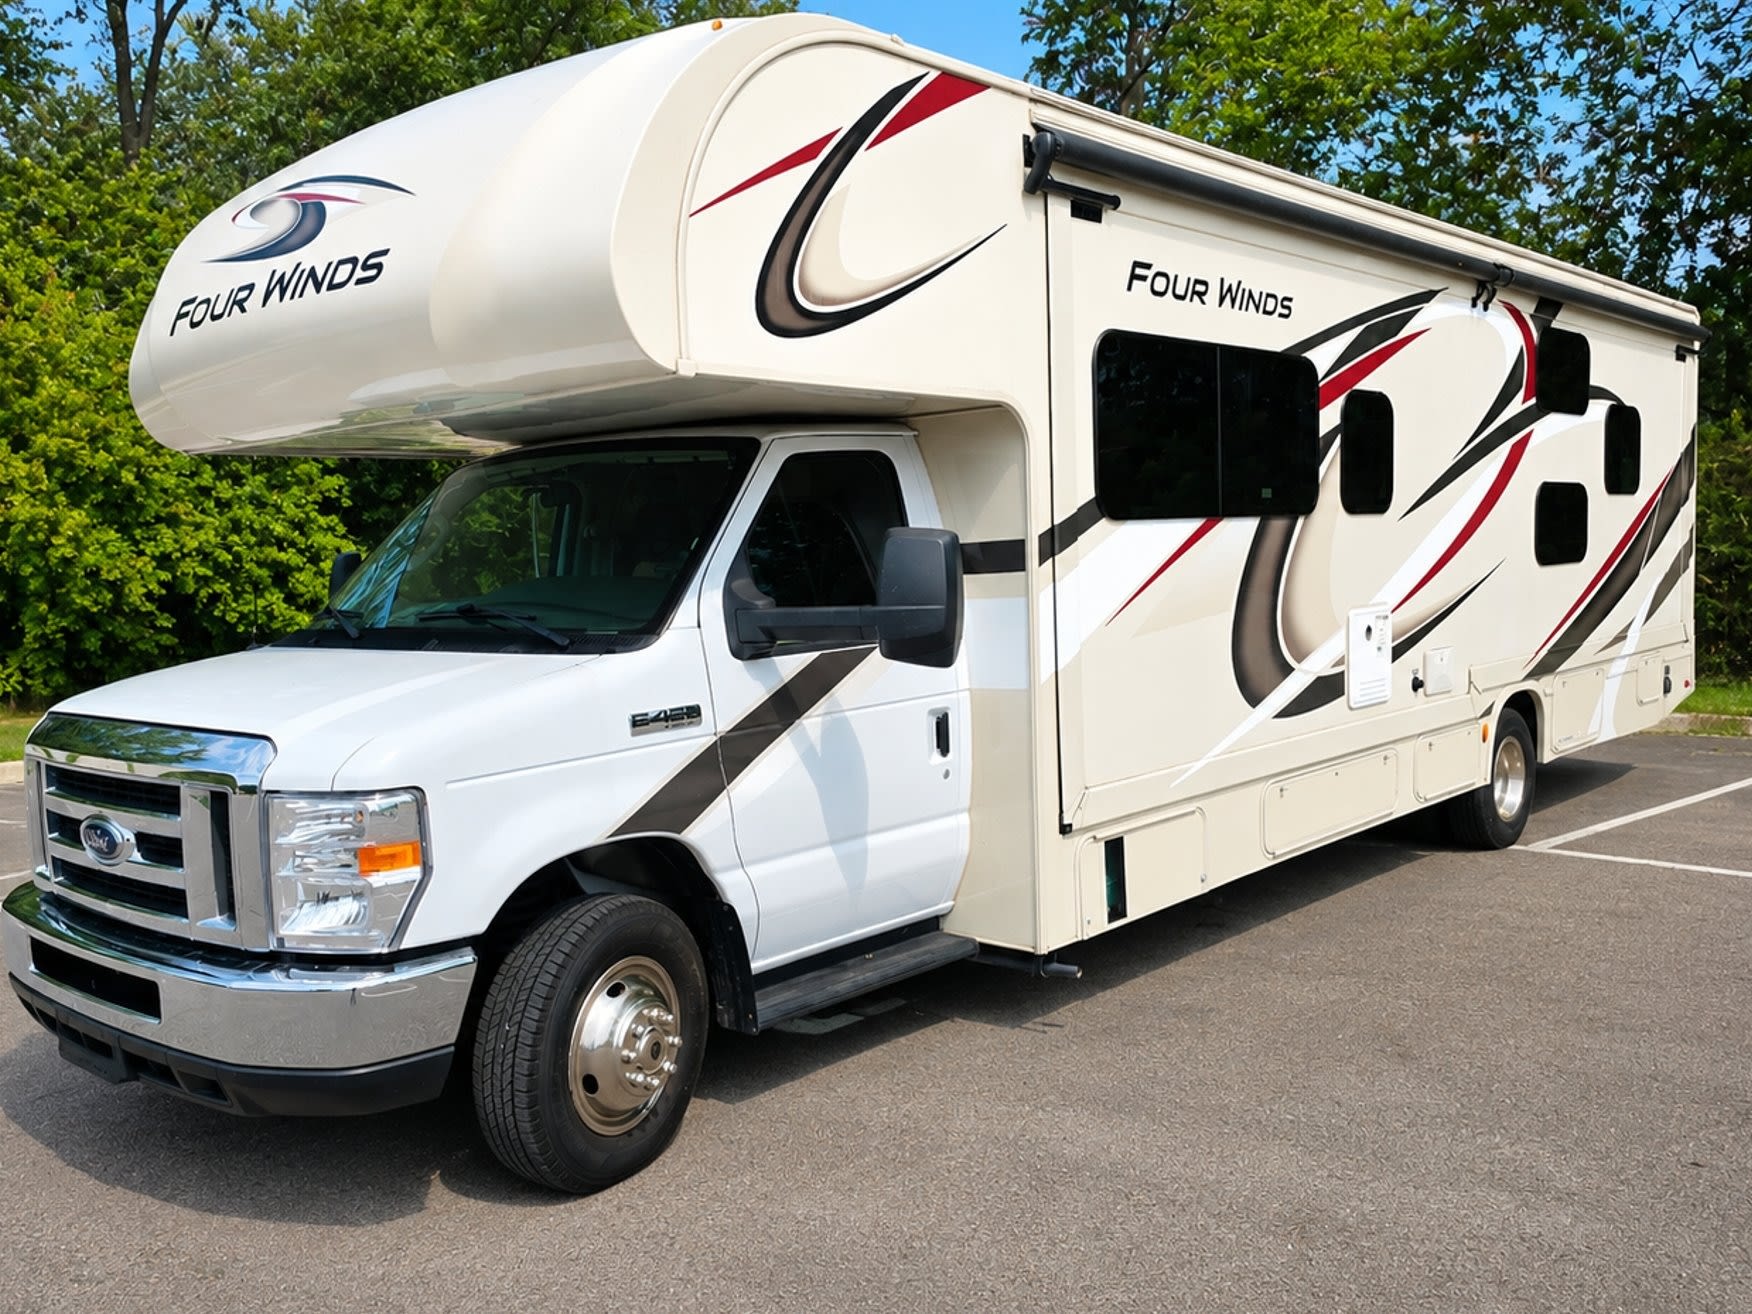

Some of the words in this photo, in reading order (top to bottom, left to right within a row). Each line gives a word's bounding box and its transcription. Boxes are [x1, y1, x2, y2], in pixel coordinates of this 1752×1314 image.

[169, 282, 256, 337] FOUR
[261, 248, 391, 308] WINDS
[1126, 260, 1209, 306] FOUR
[1218, 277, 1294, 320] WINDS
